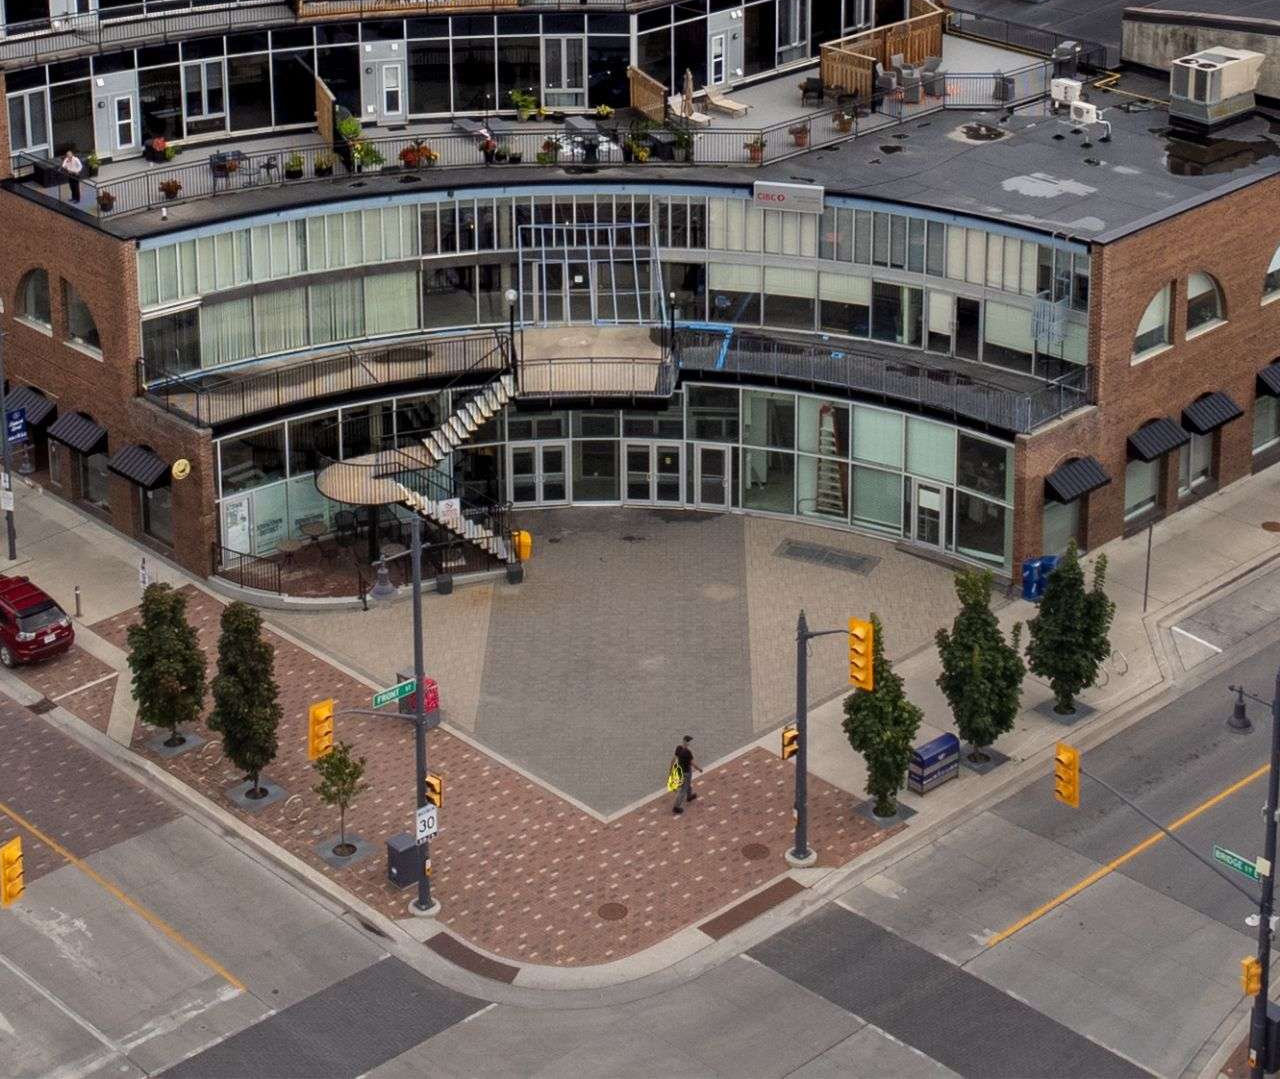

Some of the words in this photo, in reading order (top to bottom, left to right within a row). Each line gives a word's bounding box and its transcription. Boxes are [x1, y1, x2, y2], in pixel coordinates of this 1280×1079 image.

[757, 192, 776, 201] CIBC
[377, 688, 399, 704] FRONT
[419, 816, 435, 833] 30
[1216, 849, 1242, 870] BRIDGE
